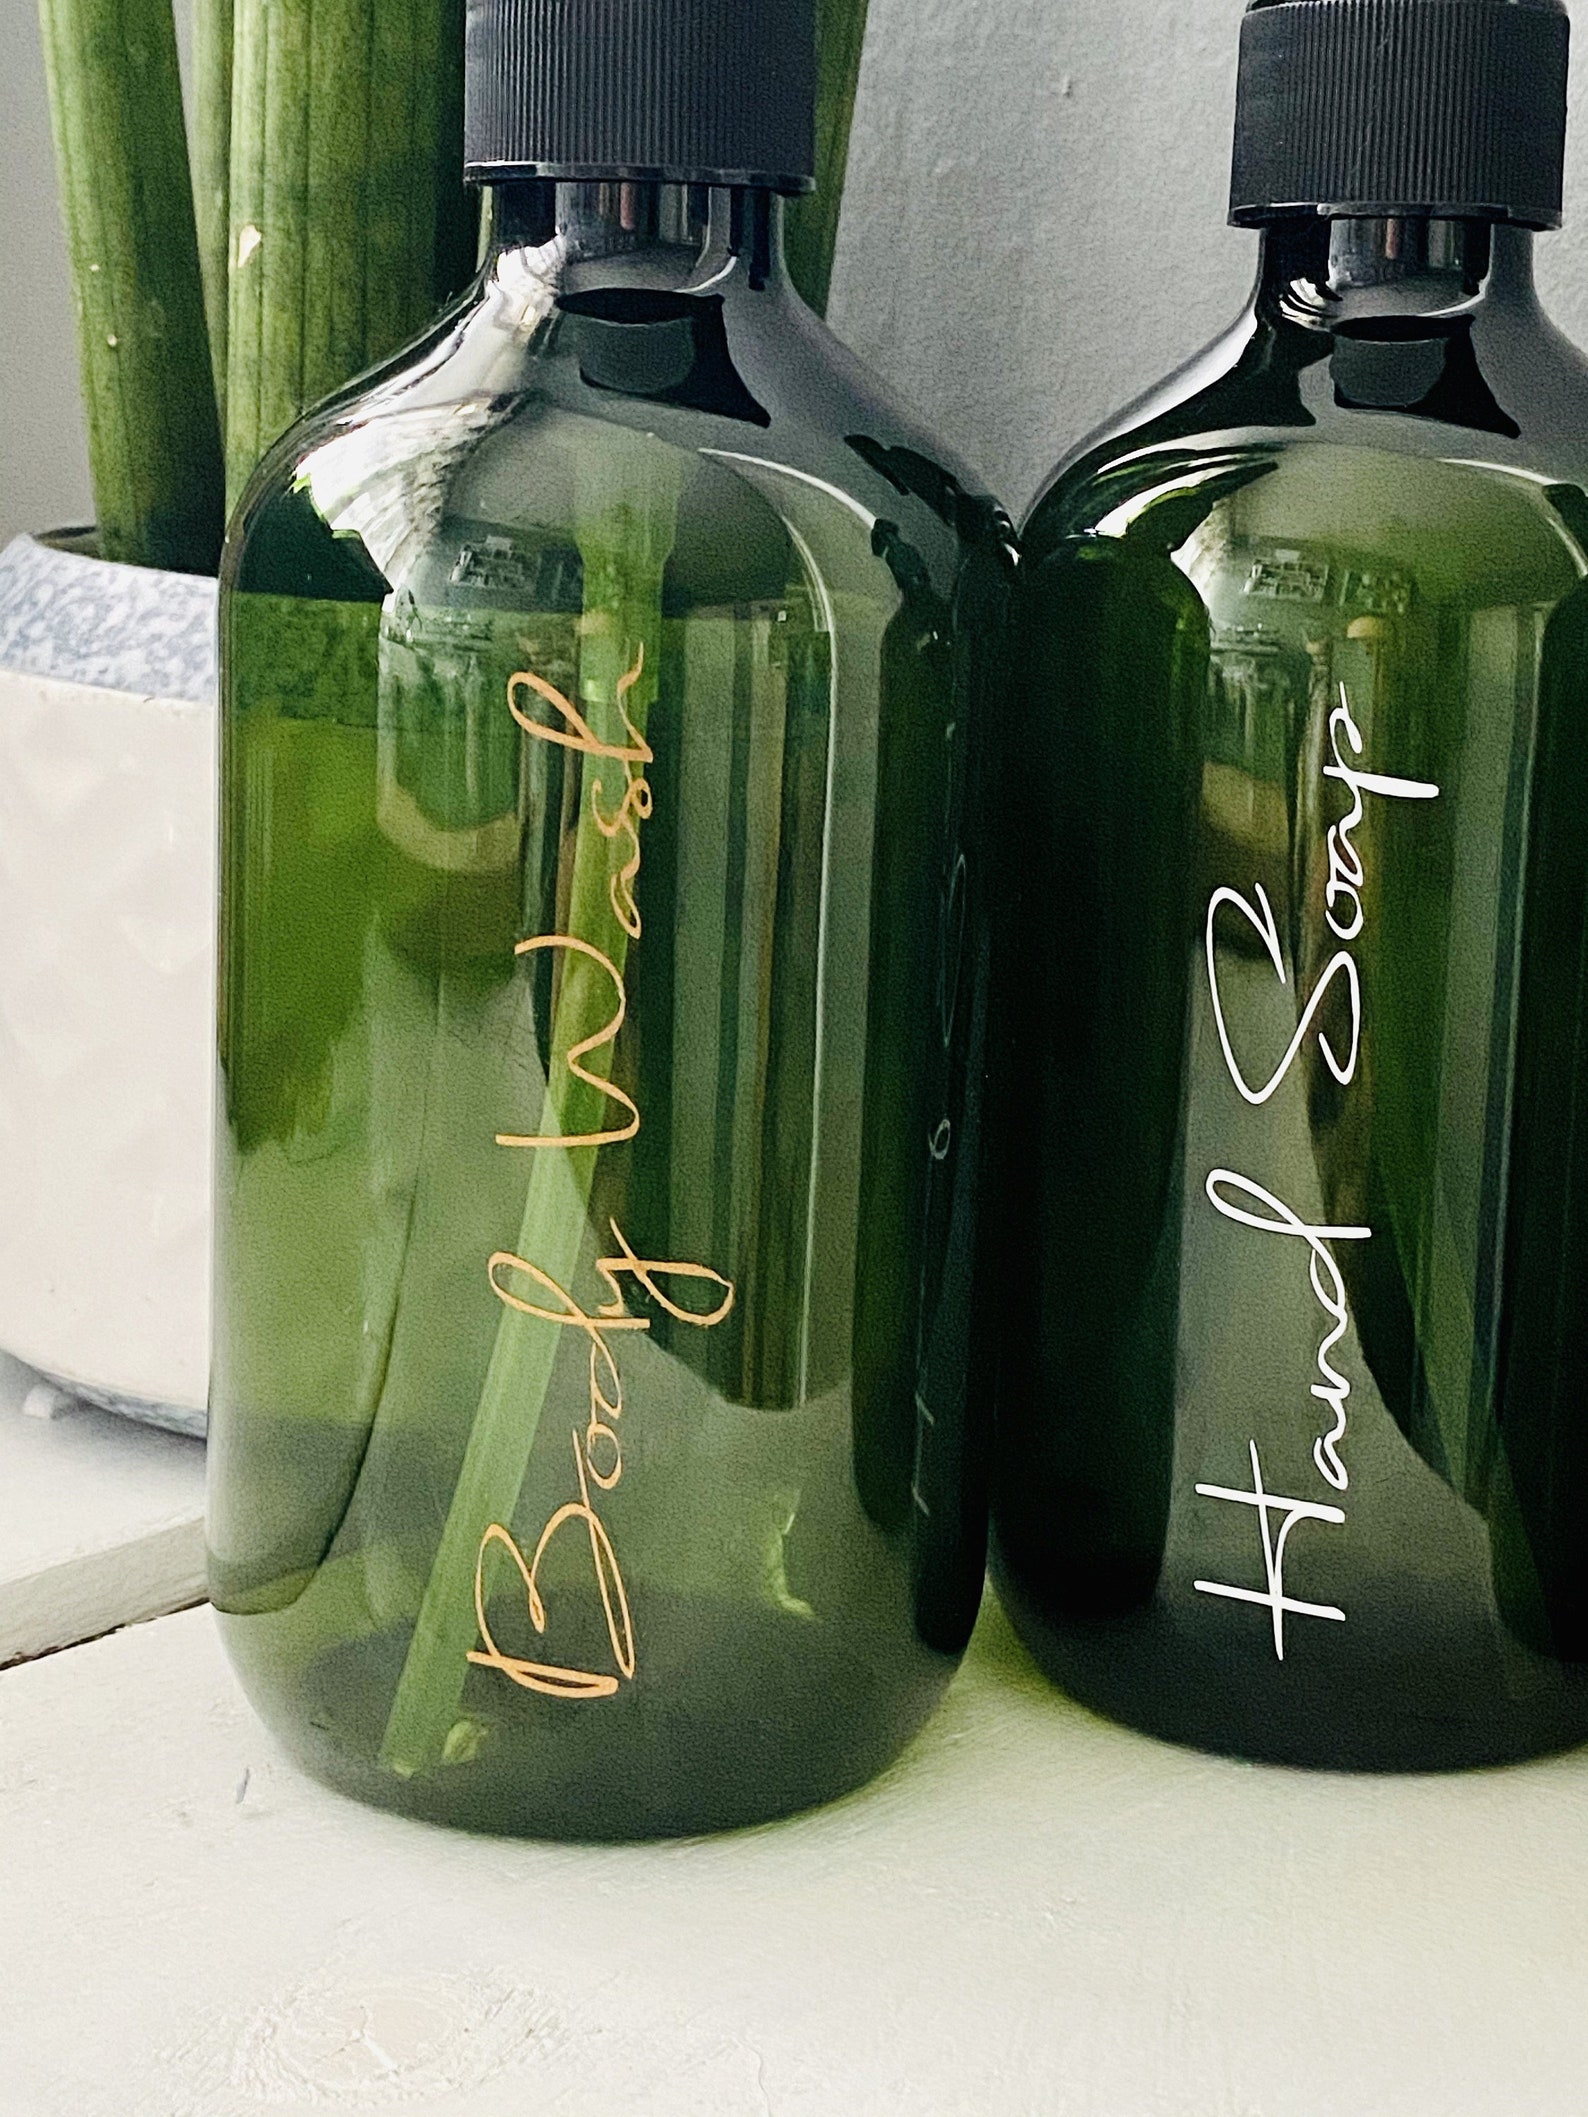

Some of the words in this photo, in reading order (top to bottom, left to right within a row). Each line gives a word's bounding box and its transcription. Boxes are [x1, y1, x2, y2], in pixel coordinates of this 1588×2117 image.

[495, 641, 653, 1147] Wash
[1206, 681, 1440, 1105] Soap
[466, 1217, 735, 1699] Body
[1194, 1168, 1372, 1661] Hand
